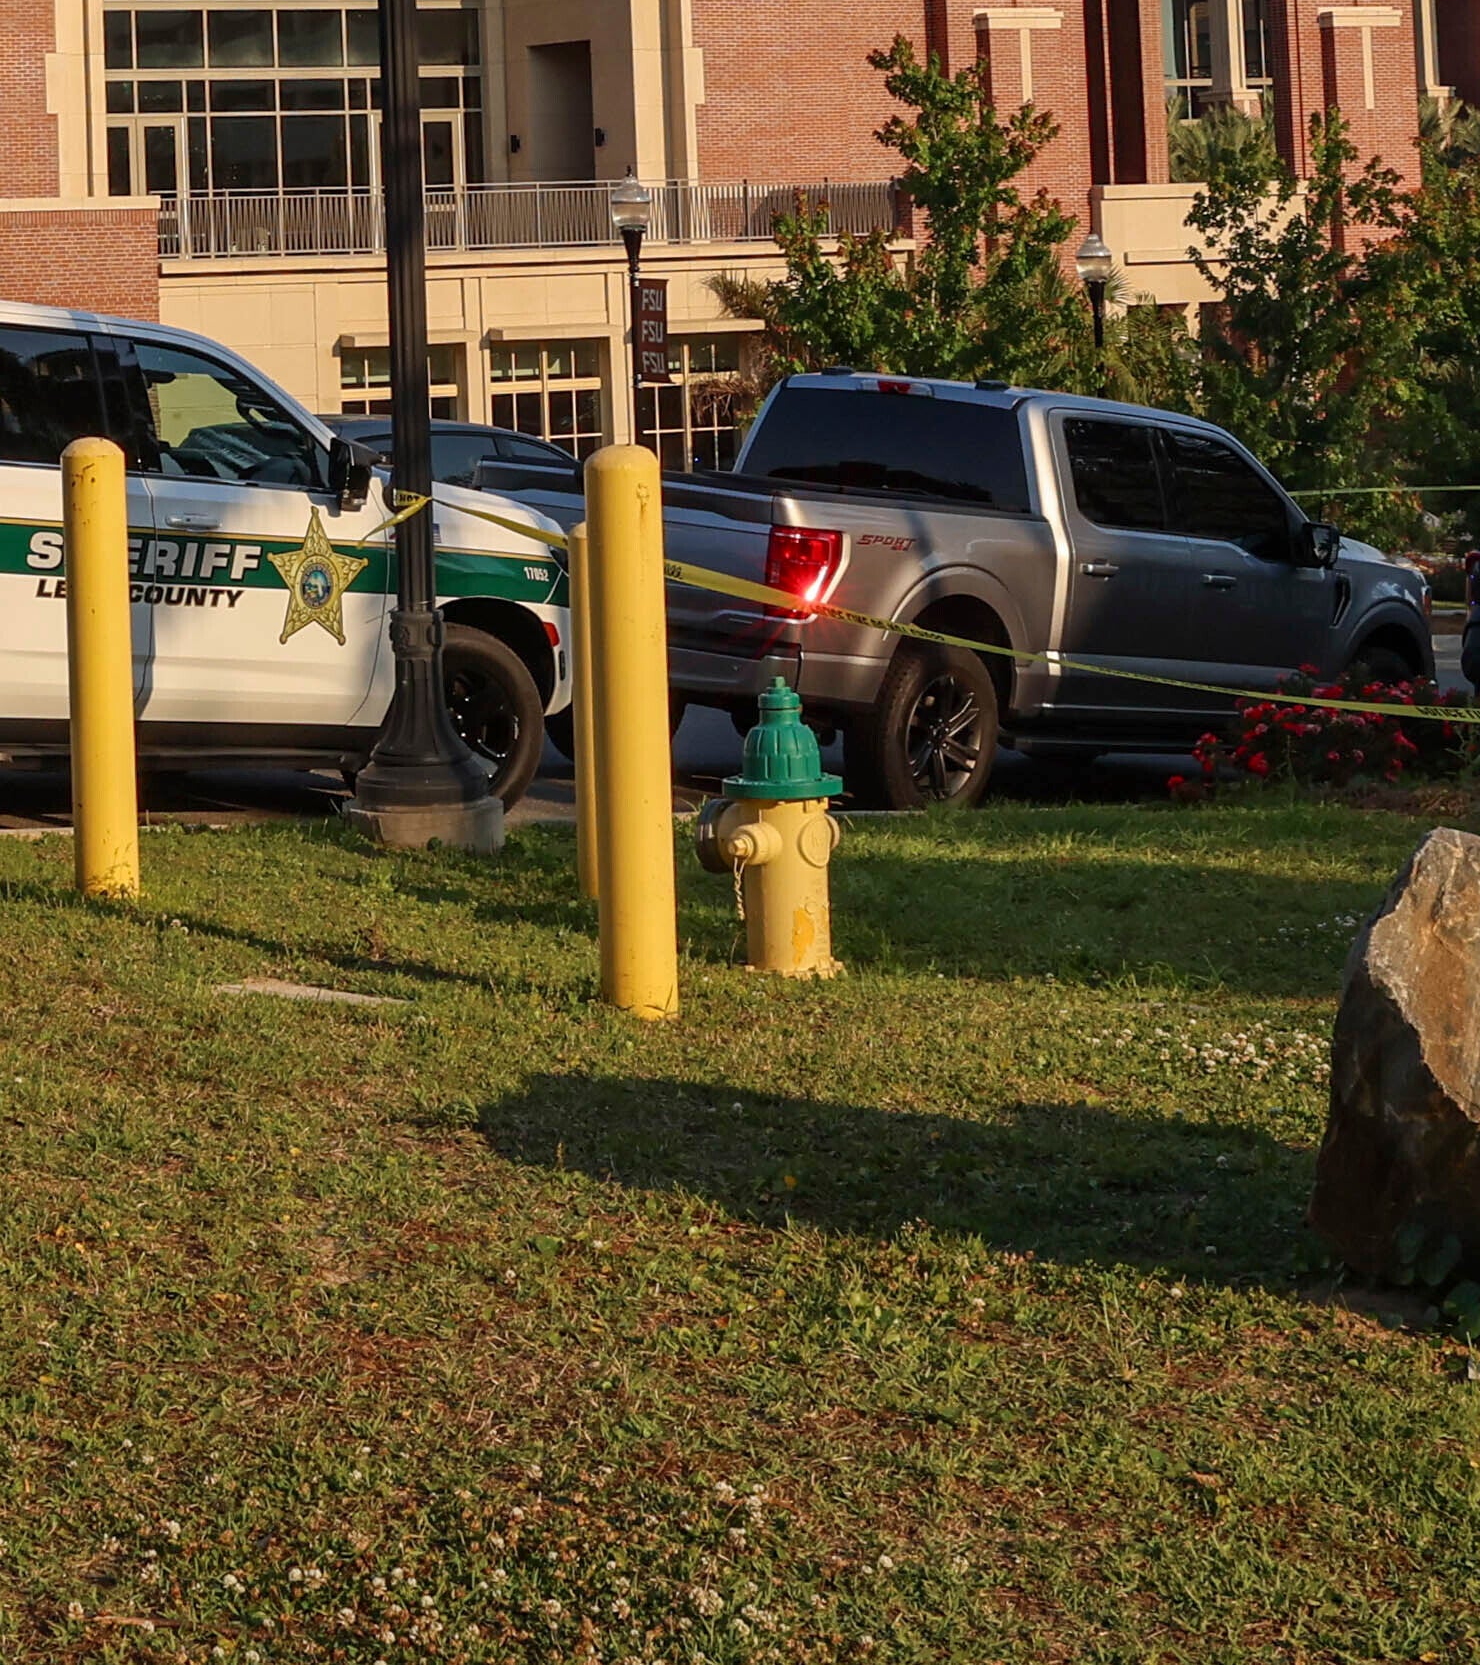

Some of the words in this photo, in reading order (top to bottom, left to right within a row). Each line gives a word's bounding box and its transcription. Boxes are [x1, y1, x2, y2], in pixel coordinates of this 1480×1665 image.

[642, 289, 663, 311] FSU
[642, 320, 663, 343] FSU
[642, 351, 665, 374] FSU
[856, 534, 918, 550] SPORT
[26, 531, 263, 580] SERIFF
[524, 566, 550, 582] 17052
[36, 579, 67, 600] LE
[129, 585, 245, 608] COUNTY
